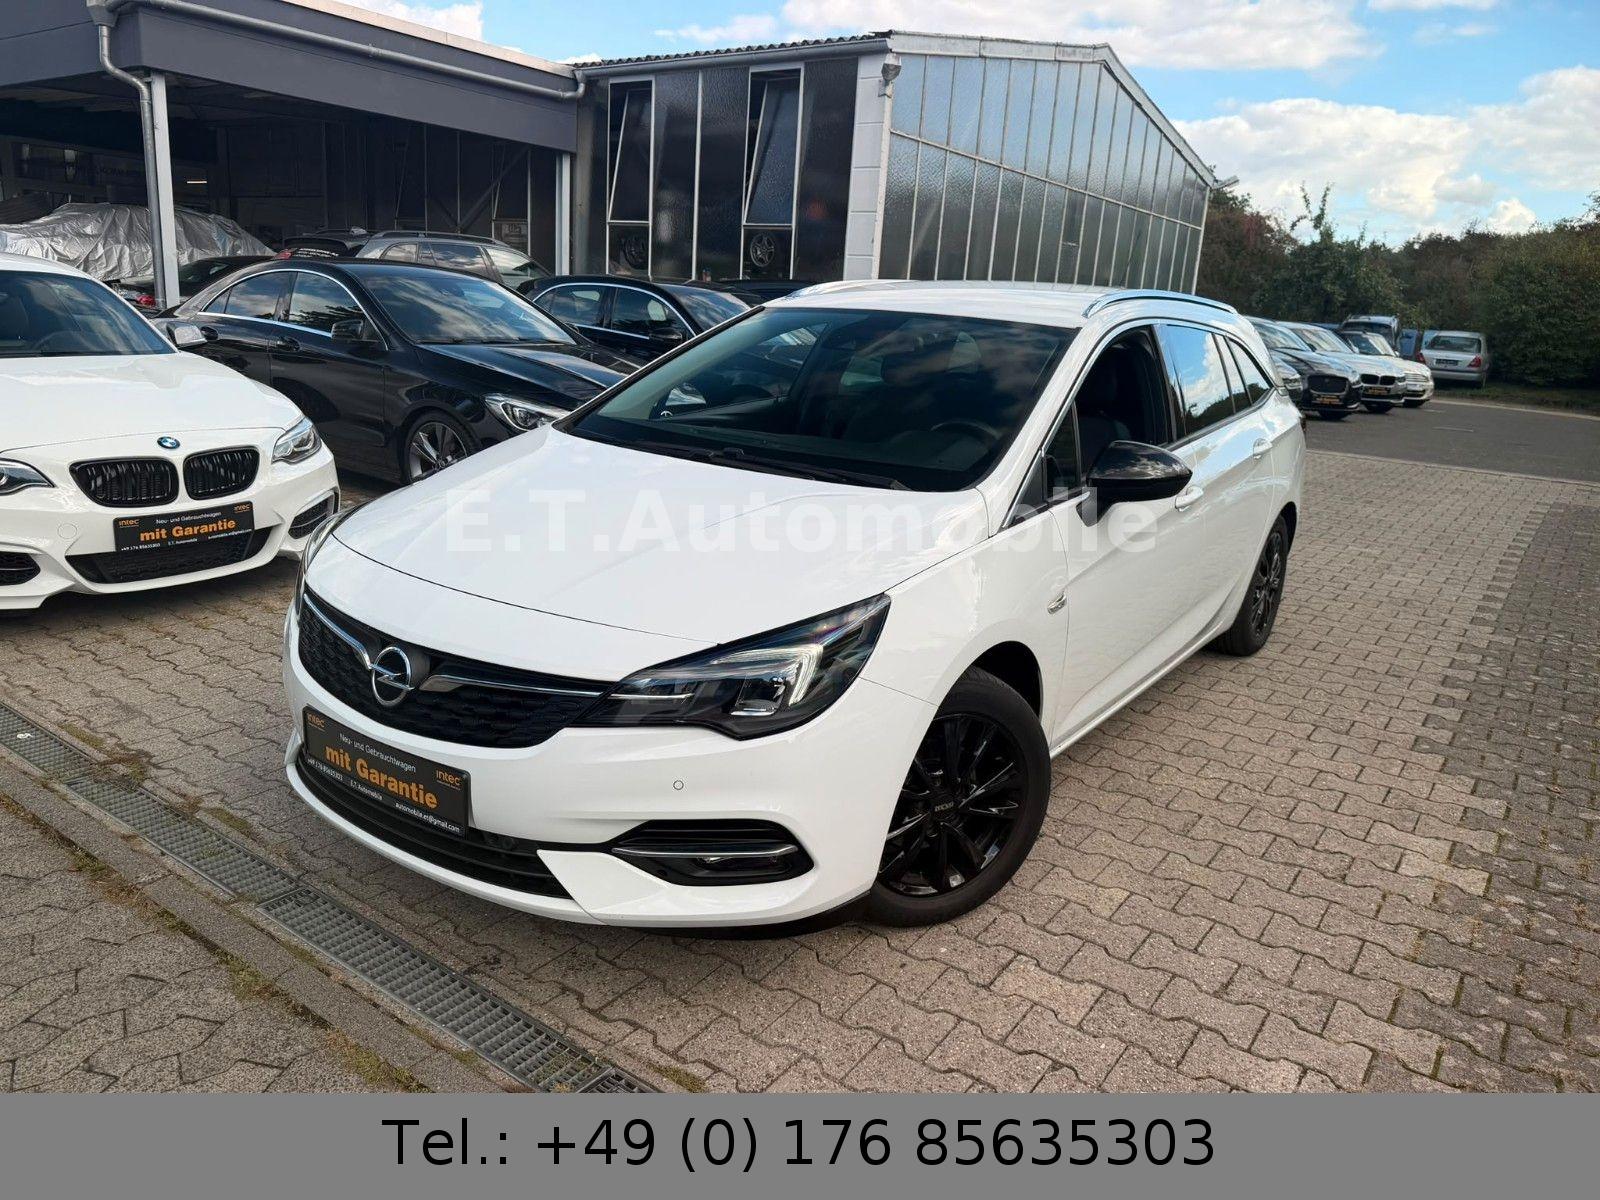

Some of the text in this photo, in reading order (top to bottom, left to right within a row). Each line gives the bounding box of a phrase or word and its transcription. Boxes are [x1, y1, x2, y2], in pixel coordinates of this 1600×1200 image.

[140, 519, 236, 541] mit Garantie
[365, 745, 416, 773] Gebrauchtwagen
[325, 745, 438, 809] mit Garantie
[436, 769, 461, 786] intec
